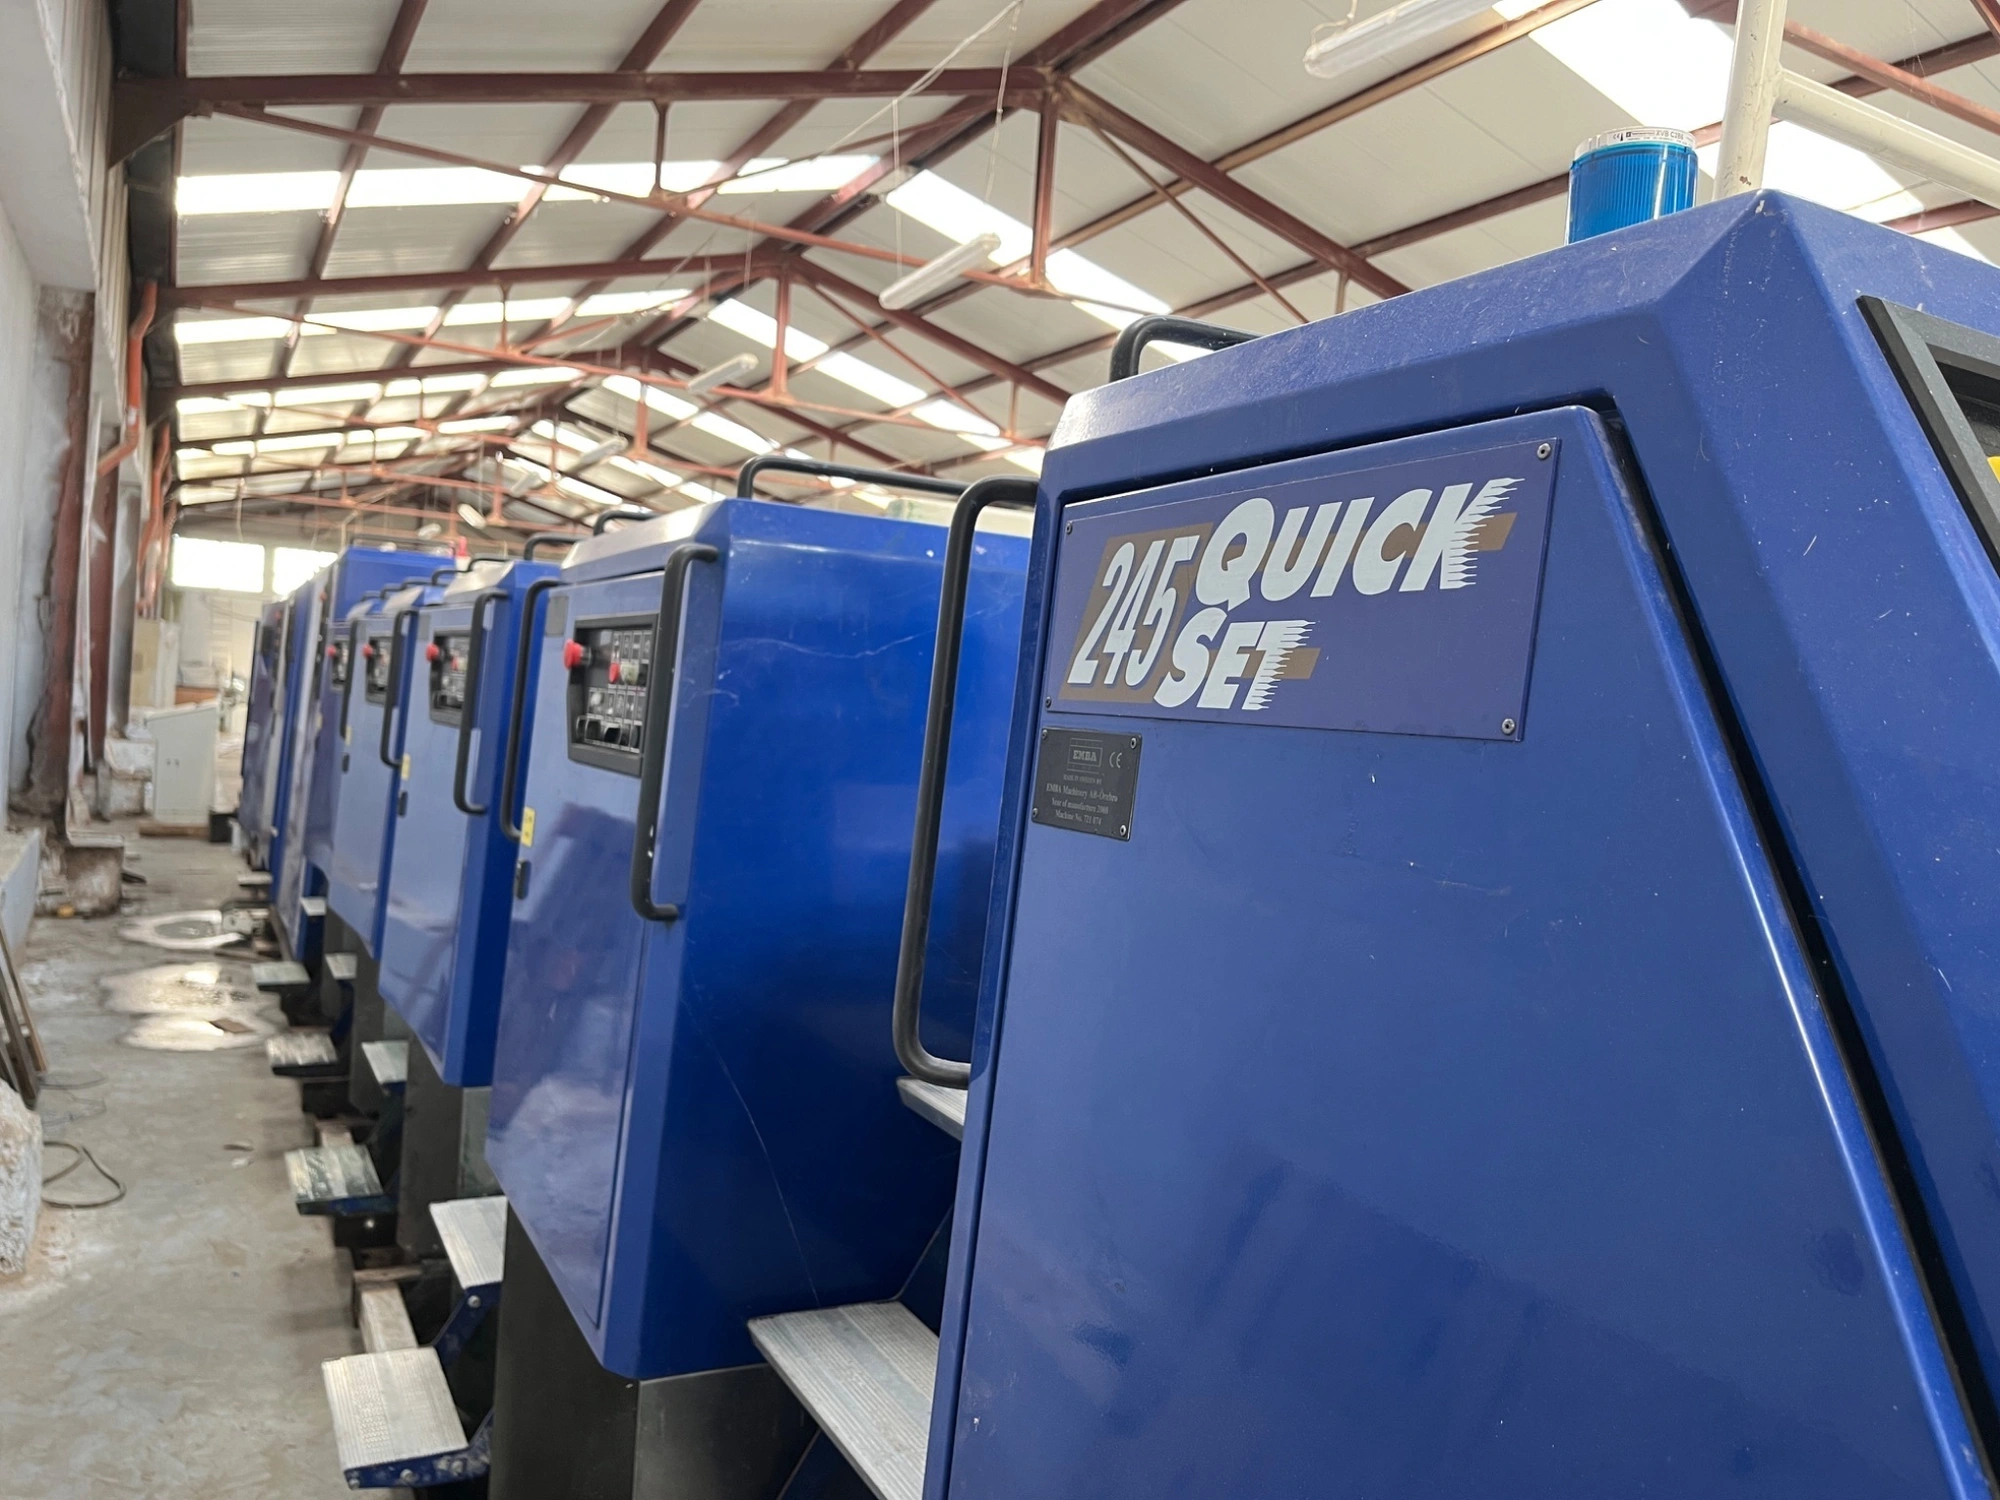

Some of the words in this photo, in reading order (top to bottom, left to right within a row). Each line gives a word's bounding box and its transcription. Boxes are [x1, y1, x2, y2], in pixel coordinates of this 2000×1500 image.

[1066, 535, 1200, 687] 245
[1195, 476, 1526, 612] QUICK
[1152, 606, 1317, 711] SET
[1073, 750, 1097, 762] EMBA
[1046, 782, 1062, 793] EMBA
[1064, 785, 1087, 799] Machinery
[1052, 797, 1062, 807] Year
[1062, 798, 1068, 808] of
[1067, 802, 1097, 813] manufacture
[1056, 809, 1074, 820] Machine
[1075, 812, 1083, 821] No.
